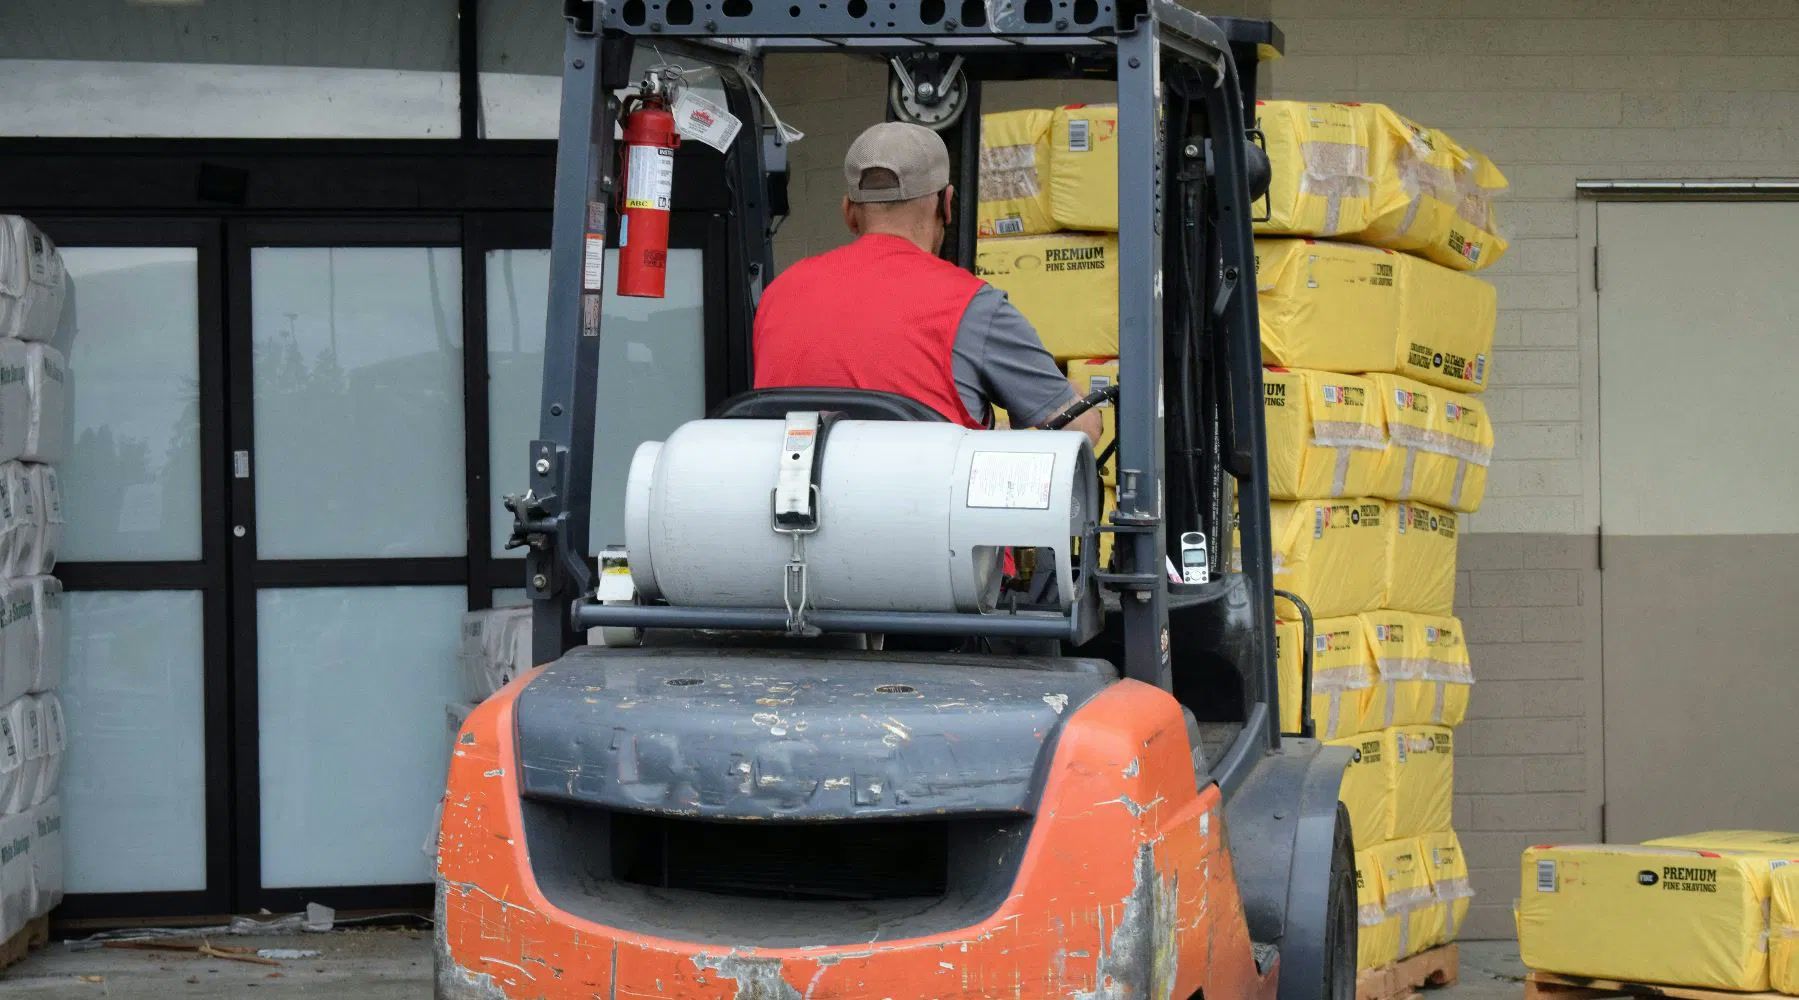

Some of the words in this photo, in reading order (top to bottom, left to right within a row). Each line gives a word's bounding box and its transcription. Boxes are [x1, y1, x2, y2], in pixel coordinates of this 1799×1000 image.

[1046, 247, 1104, 261] PREMIUM
[1046, 263, 1065, 272] PINE
[1066, 260, 1105, 271] SHAVINGS
[1663, 867, 1717, 882] PREMIUM
[1663, 881, 1680, 891] PINE
[1682, 882, 1717, 893] SHAVINGS
